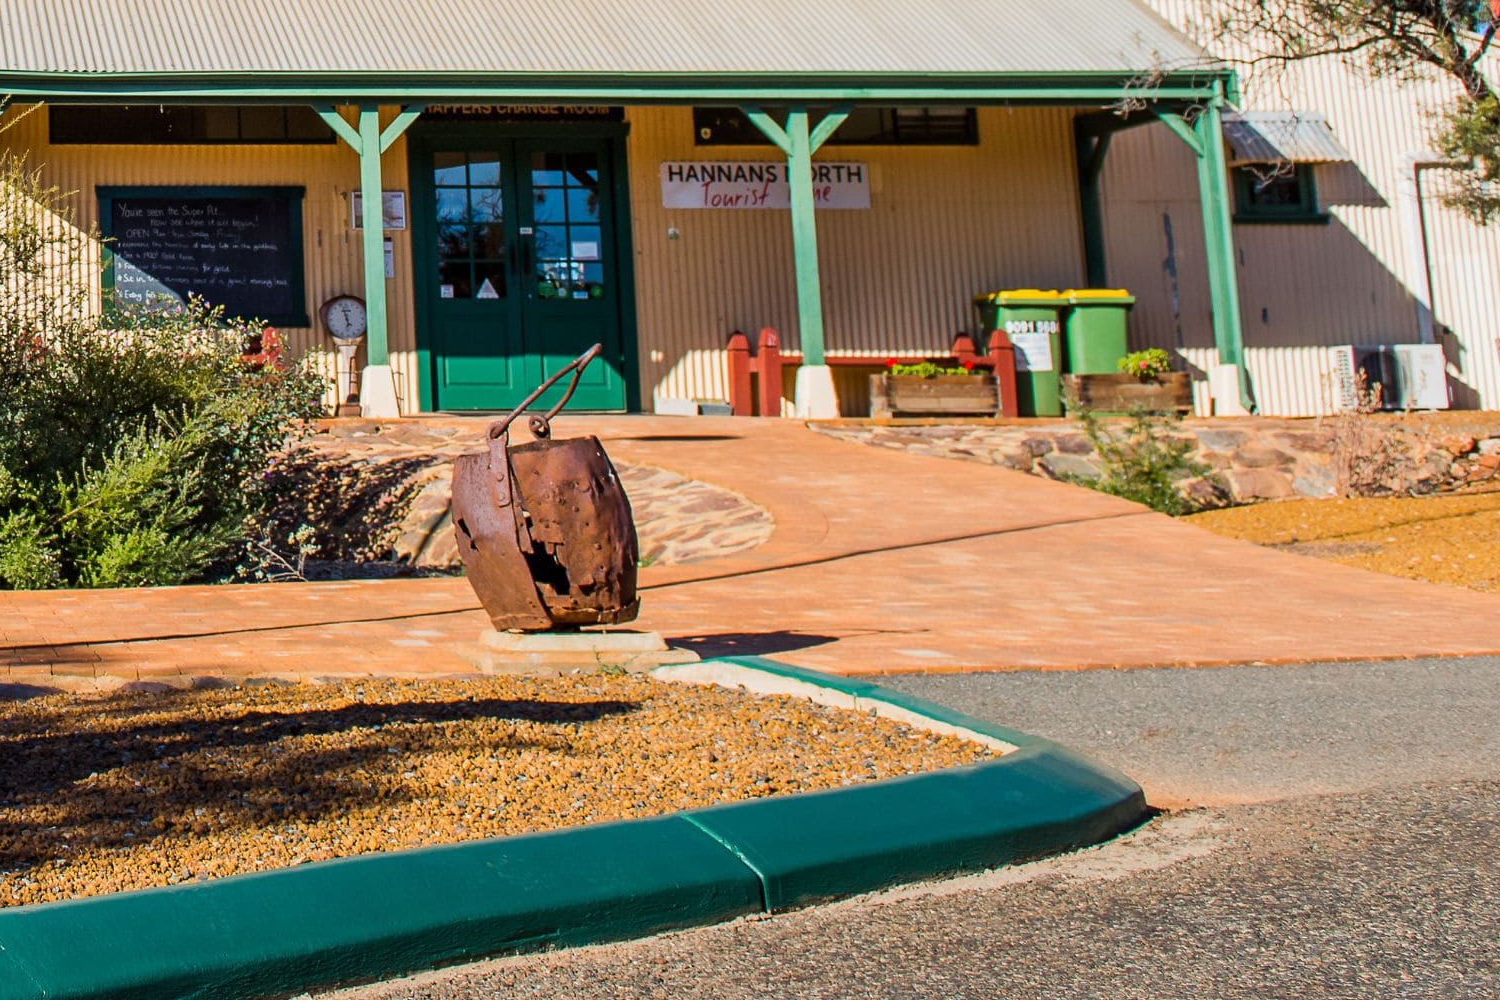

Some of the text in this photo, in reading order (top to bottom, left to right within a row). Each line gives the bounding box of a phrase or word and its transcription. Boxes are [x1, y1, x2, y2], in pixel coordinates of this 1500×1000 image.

[668, 164, 862, 183] HANNANS RTH
[701, 175, 770, 207] Tourist
[147, 208, 163, 216] seen
[167, 205, 179, 215] the
[181, 205, 204, 217] Super
[126, 229, 149, 238] OPEN
